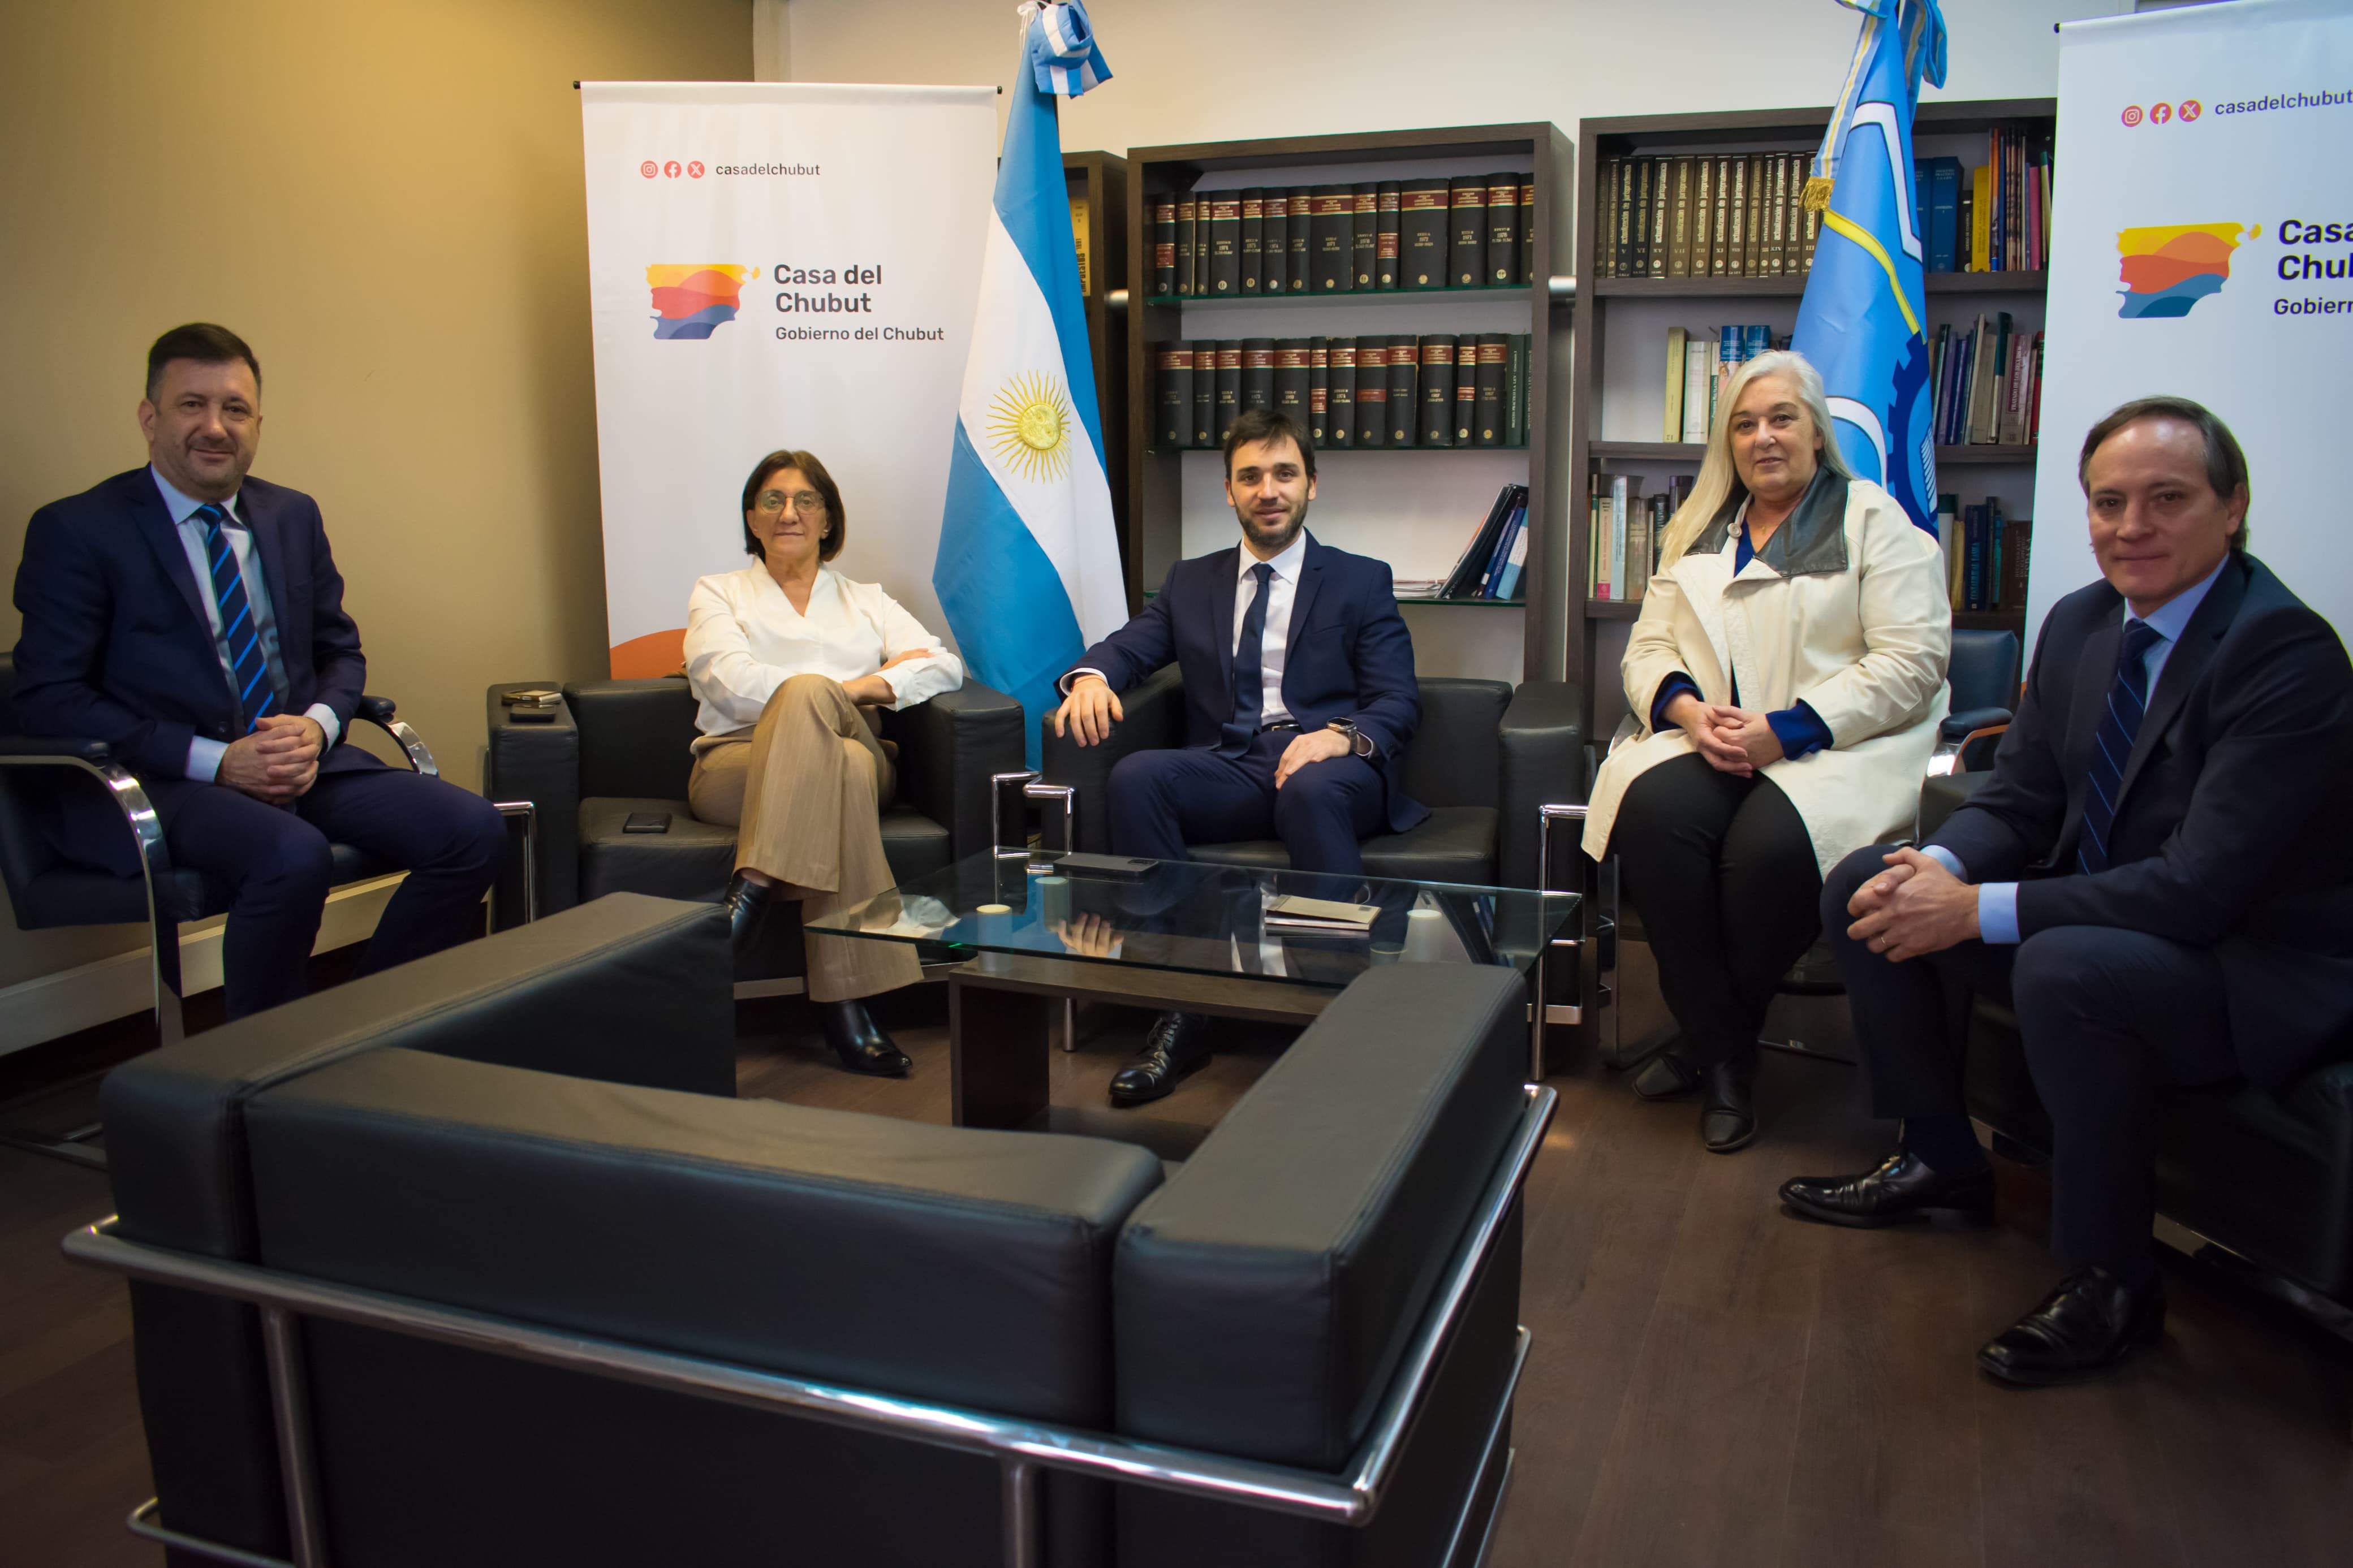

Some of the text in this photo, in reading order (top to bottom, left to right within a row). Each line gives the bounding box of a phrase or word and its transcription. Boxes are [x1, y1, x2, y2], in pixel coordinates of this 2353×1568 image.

[2214, 89, 2353, 115] casadelchubut
[716, 163, 821, 176] casadelchubut
[1622, 165, 1632, 201] jurisprudencia
[1657, 162, 1667, 200] jurisprudencia
[1678, 162, 1687, 199] jurisprudencia
[1699, 162, 1709, 198] jurisprudencia
[1718, 162, 1727, 198] jurisprudencia
[1734, 162, 1744, 198] jurisprudencia
[1775, 158, 1785, 196] jurisprudencia
[1791, 159, 1800, 197] jurisprudencia
[1655, 209, 1664, 243] actualización
[1697, 209, 1706, 243] actualización
[1716, 209, 1725, 242] actualización
[1733, 209, 1741, 243] actualización
[1773, 206, 1782, 240] actualización
[774, 264, 882, 284] Casa del
[2277, 253, 2353, 280] Chu
[775, 293, 871, 313] Chubut
[775, 327, 944, 340] Gobierno del Chubut
